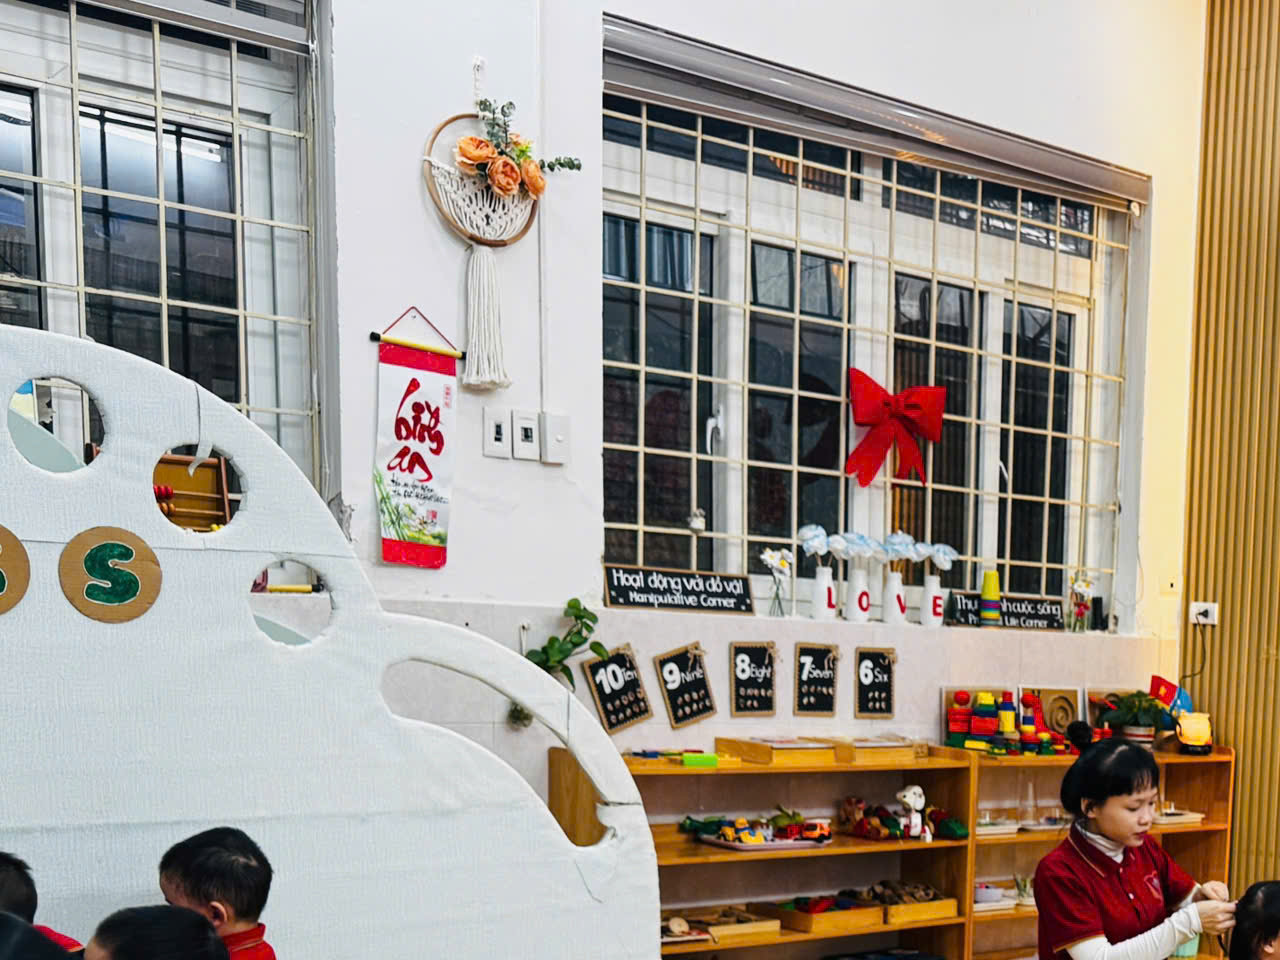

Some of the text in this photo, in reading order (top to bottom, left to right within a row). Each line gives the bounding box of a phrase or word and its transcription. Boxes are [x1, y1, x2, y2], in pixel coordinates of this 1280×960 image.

[648, 571, 682, 595] động
[629, 591, 737, 608] Manipulative Corner
[595, 663, 638, 694] 10 Ten
[663, 662, 704, 690] 9 Nine
[735, 653, 771, 683] 8 Eight
[800, 655, 834, 681] 7 Seven
[859, 659, 888, 685] 6 Six
